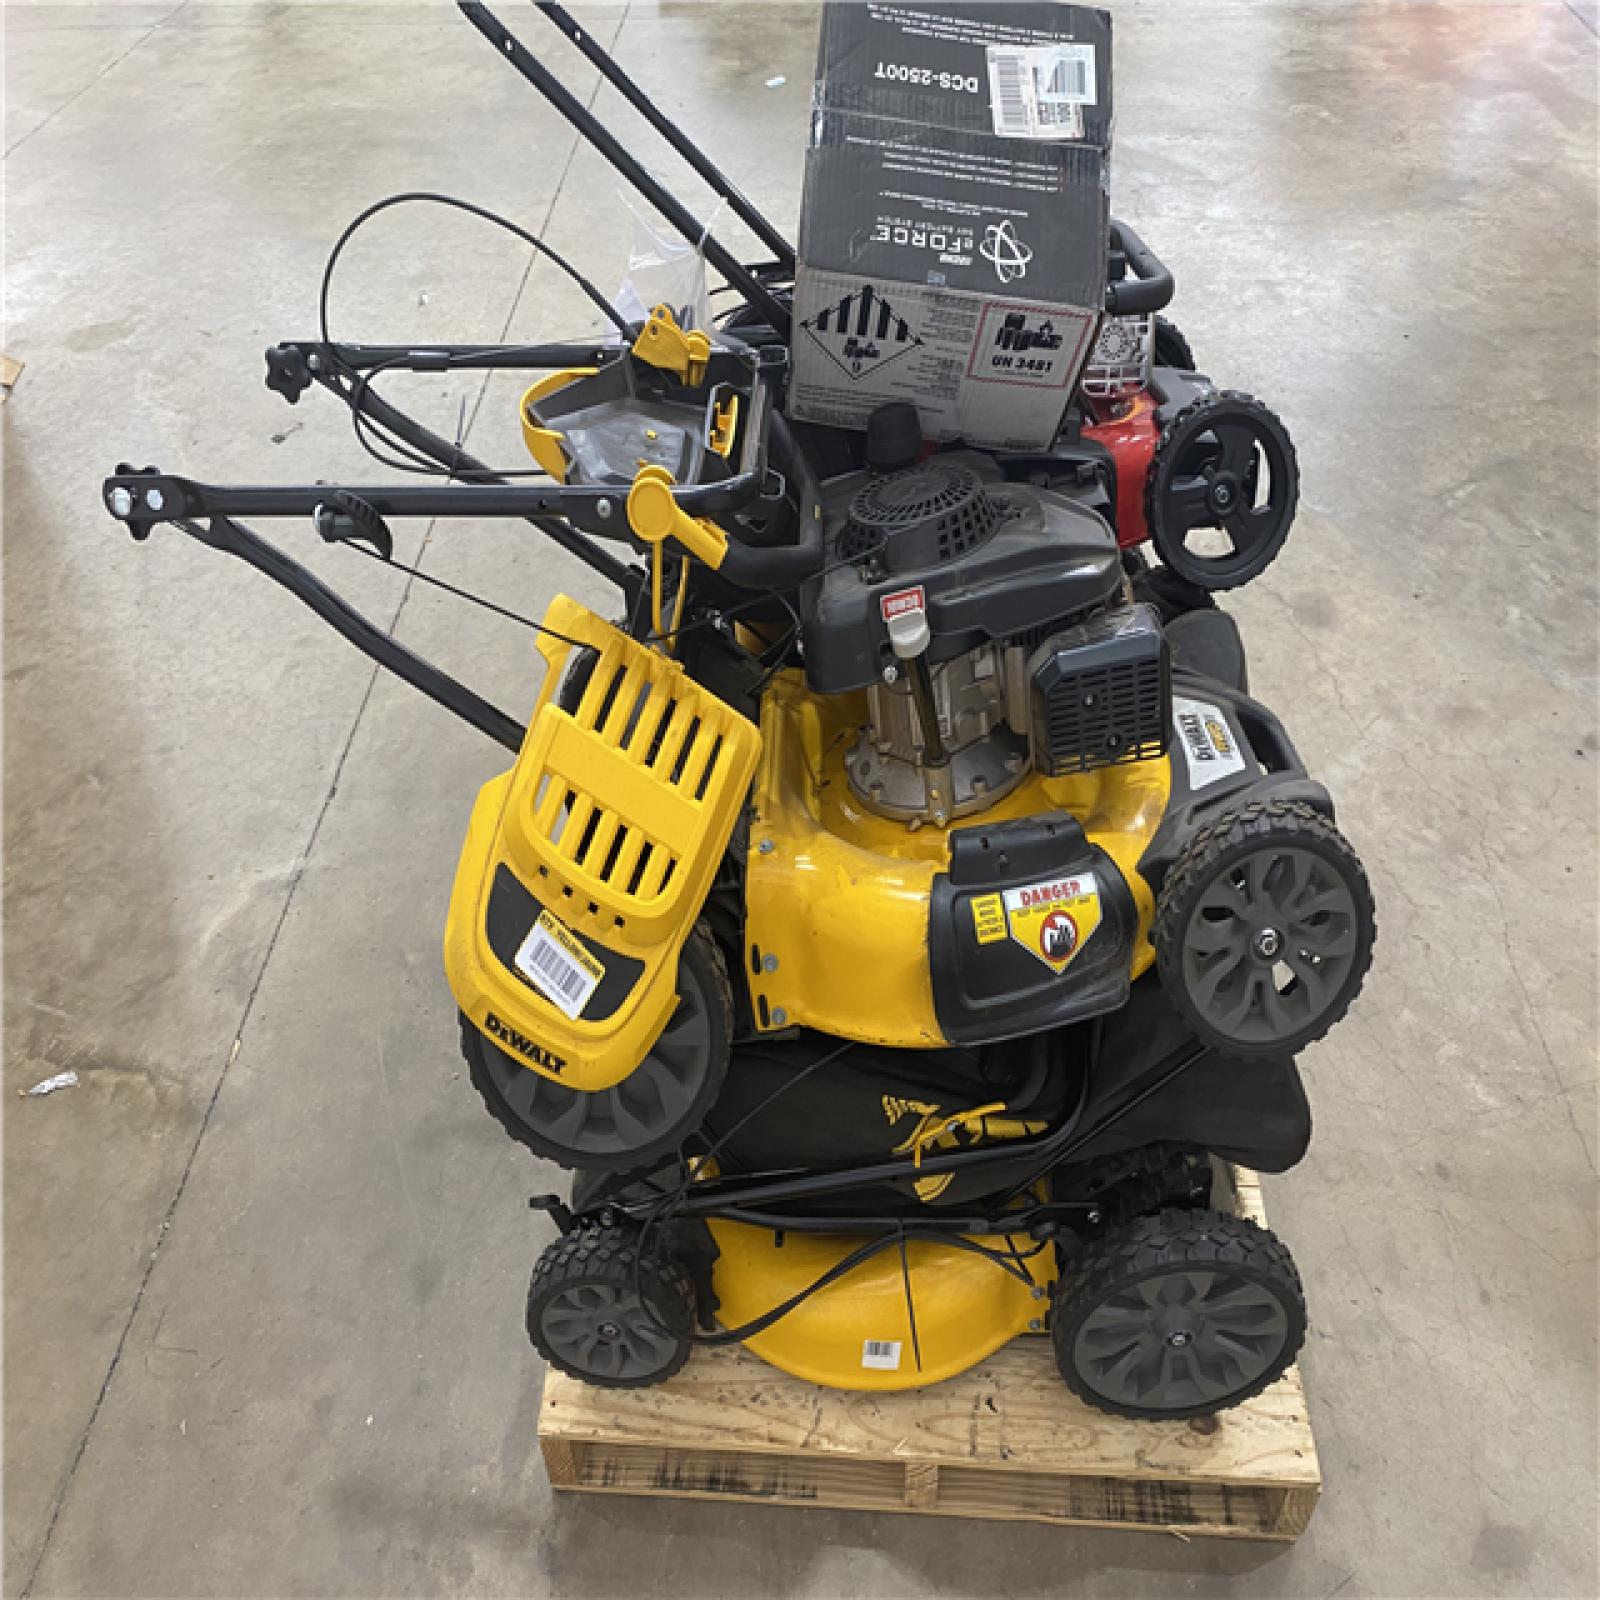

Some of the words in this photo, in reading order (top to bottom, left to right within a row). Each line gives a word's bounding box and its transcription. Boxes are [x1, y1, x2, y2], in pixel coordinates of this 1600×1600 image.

[874, 61, 978, 93] DCS-2500T
[992, 355, 1012, 369] UN
[1015, 357, 1053, 373] 3481
[1019, 880, 1081, 906] DANGER
[485, 1012, 568, 1074] DEWALT
